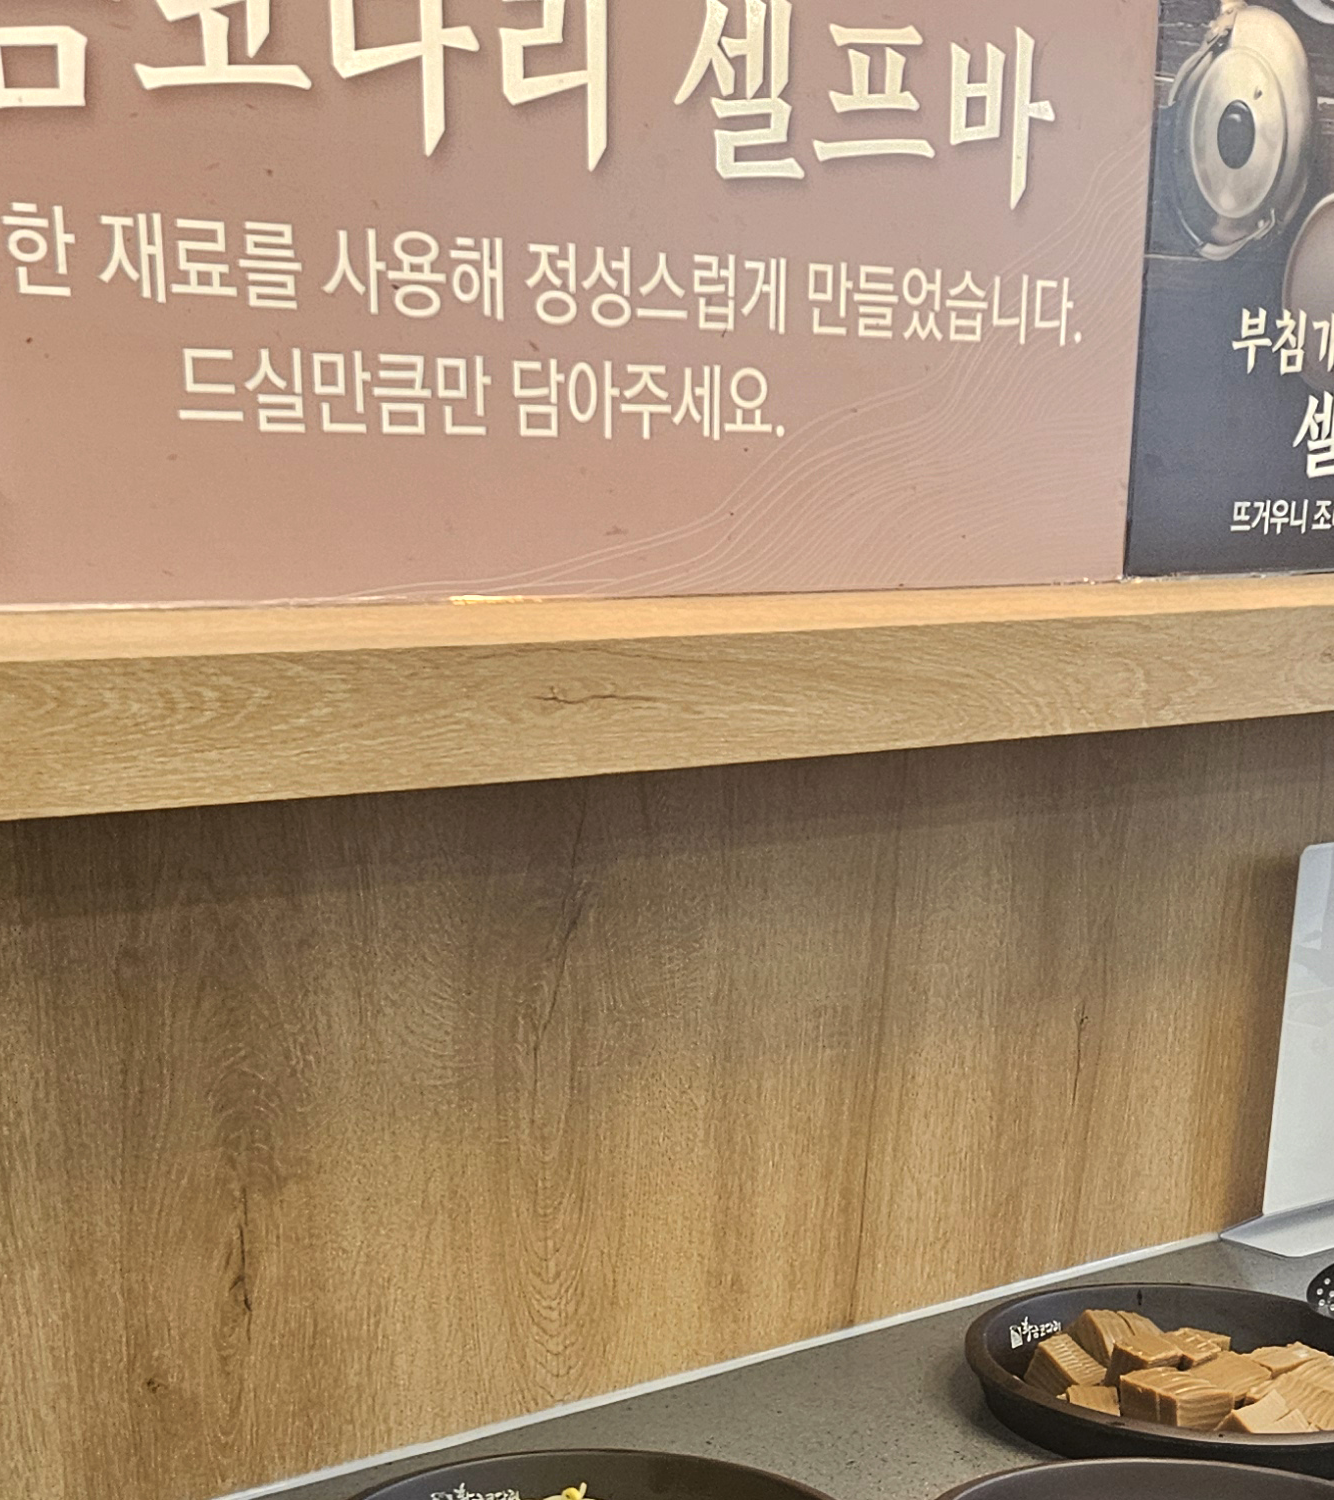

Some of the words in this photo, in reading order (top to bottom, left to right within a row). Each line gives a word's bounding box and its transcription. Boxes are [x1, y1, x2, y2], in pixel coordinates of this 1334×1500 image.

[673, 0, 1056, 210] 셀프바
[99, 211, 303, 311] 재료를
[322, 229, 505, 322] 사용해
[524, 240, 788, 334] 정성스럽게
[805, 255, 1084, 348] 만들었습니다.
[177, 345, 490, 437] 드실만큼만
[509, 358, 787, 443] 담아주세요.
[1230, 499, 1307, 535] 뜨거우니
